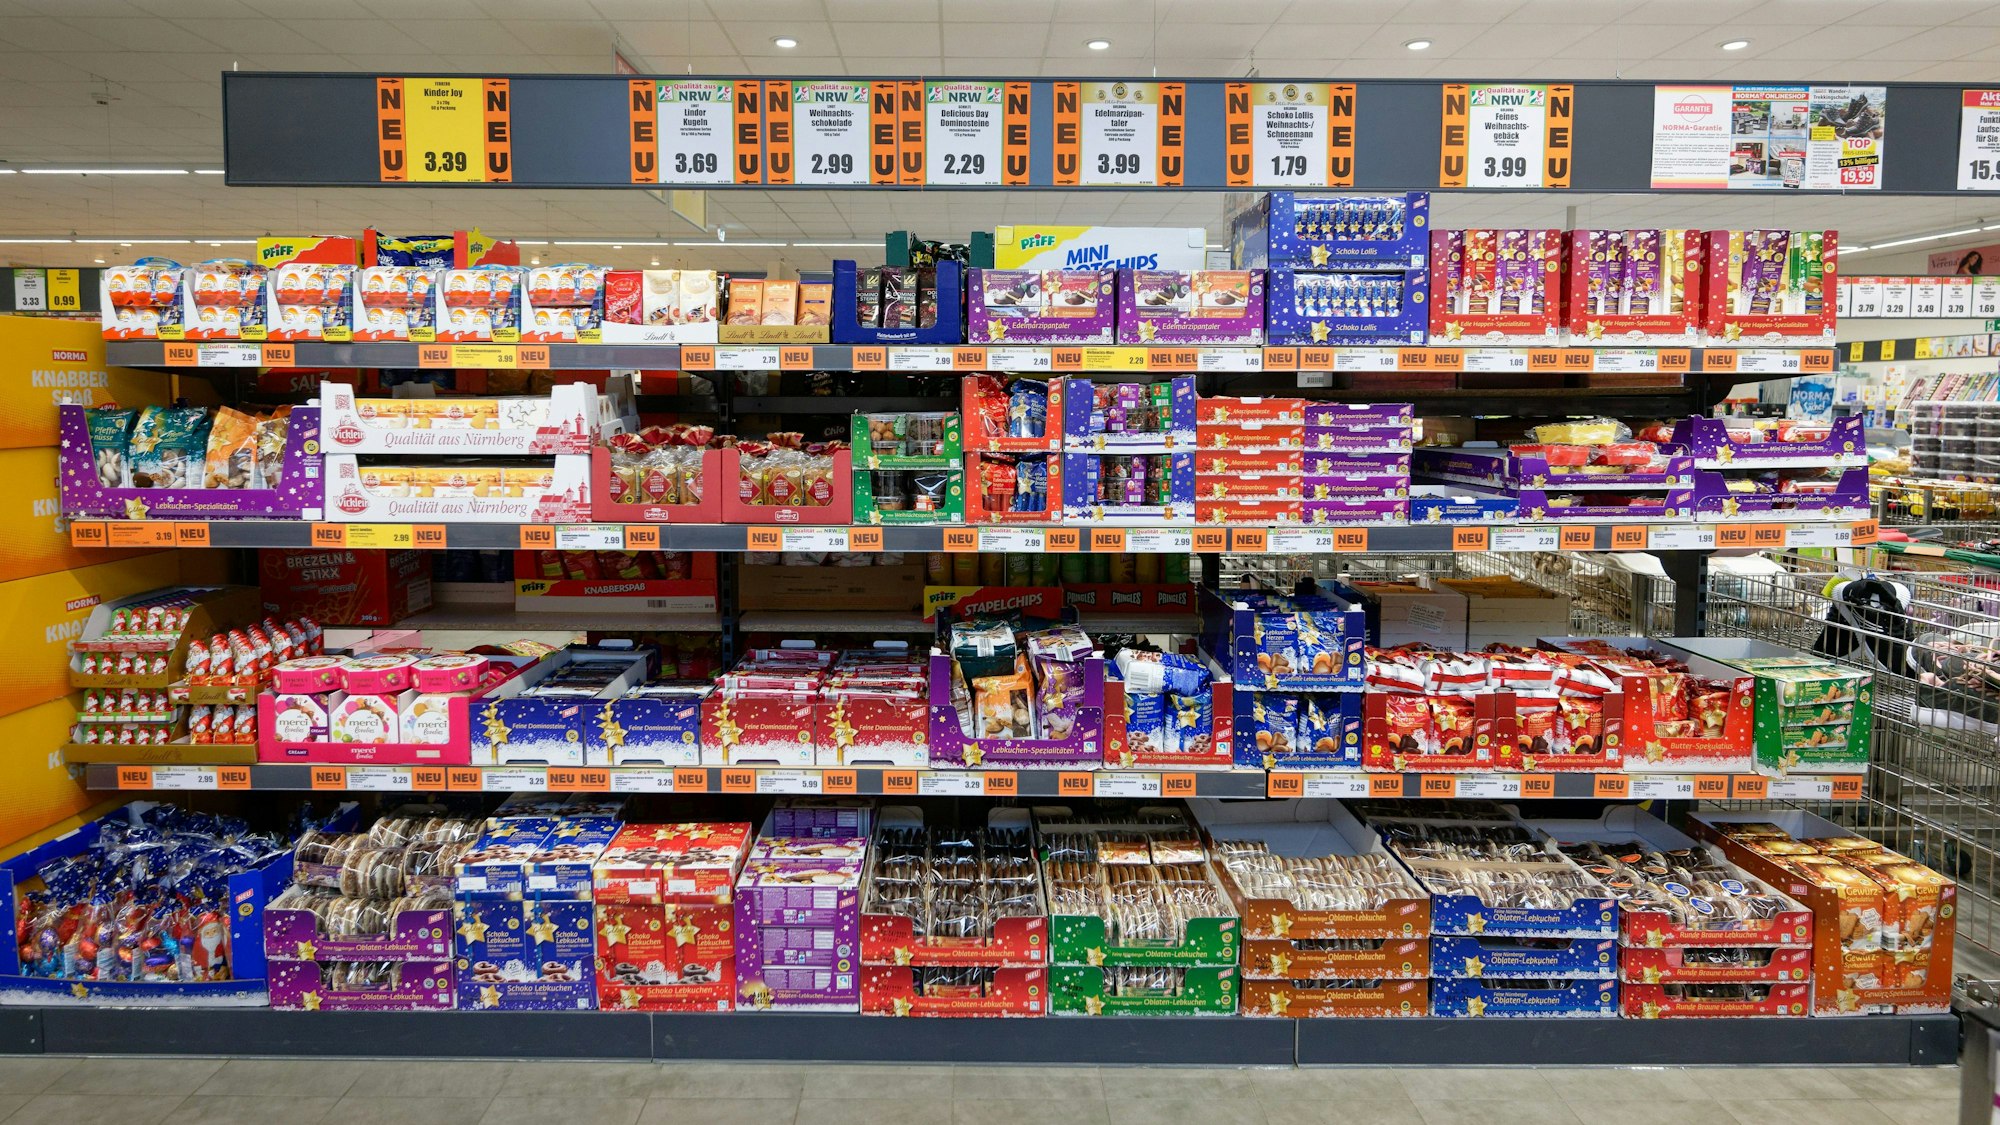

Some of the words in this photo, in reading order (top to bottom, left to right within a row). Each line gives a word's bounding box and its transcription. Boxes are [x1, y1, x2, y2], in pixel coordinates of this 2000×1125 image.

[451, 89, 463, 97] Joy
[679, 91, 711, 101] NRW
[816, 92, 848, 101] NRW
[949, 92, 981, 102] NRW
[1491, 96, 1524, 105] NRW
[976, 110, 988, 118] Day
[1095, 110, 1144, 118] Edelmarzipan-
[683, 118, 708, 127] Kugeln
[381, 89, 402, 171] NEU
[633, 91, 653, 172] NEU
[770, 92, 789, 173] NEU
[902, 91, 921, 173] NEU
[1058, 93, 1076, 174] NEU
[1332, 96, 1352, 178] NEU
[1494, 132, 1519, 140] gebäck
[1549, 97, 1569, 178] NEU
[1849, 139, 1870, 148] TOP
[425, 152, 467, 172] 3,39
[675, 153, 717, 174] 3,69
[811, 154, 852, 174] 2,99
[944, 154, 985, 175] 2,29
[1098, 154, 1140, 174] 3,99
[1271, 156, 1307, 176] 1,79
[1856, 157, 1878, 166] billiger
[1484, 157, 1526, 178] 3,99
[1842, 171, 1873, 183] 19,99
[1066, 245, 1108, 266] MINI
[420, 258, 443, 266] CHIPS
[22, 297, 39, 306] 3.33
[54, 296, 75, 306] 0.99
[1012, 321, 1070, 330] Edelmarzipantaler
[54, 351, 86, 360] NORMA
[169, 349, 193, 358] NEU
[785, 352, 809, 362] NEU
[1305, 354, 1329, 362] NEU
[936, 357, 950, 366] 2.99
[1662, 356, 1686, 364] NEU
[32, 371, 108, 387] KNABBER
[95, 427, 119, 436] Pfeffer-
[824, 426, 845, 436] Chio
[385, 432, 436, 447] Qualität
[438, 435, 461, 445] aus
[464, 433, 524, 449] Nürnberg
[155, 502, 238, 511] Lebkuchen-Spezialitäten
[156, 532, 172, 540] 3.19
[316, 529, 342, 539] NEU
[854, 534, 878, 543] NEU
[1721, 531, 1746, 541] NEU
[1238, 535, 1262, 544] NEU
[286, 553, 343, 568] BREZELN
[345, 553, 356, 563] &
[302, 568, 340, 580] STIXX
[584, 583, 645, 594] KNABBERSPAß
[1067, 592, 1095, 604] PRINGLES
[965, 594, 1042, 617] STAPELCHIPS
[563, 708, 577, 716] NEU
[316, 773, 341, 781] NEU
[679, 775, 703, 784] NEU
[1063, 778, 1088, 788] NEU
[1526, 780, 1550, 789] NEU
[1846, 887, 1882, 896] Gewürz-
[356, 943, 418, 952] Oblaten-Lebkuchen
[1864, 990, 1925, 998] Gewürz-Spekulatius
